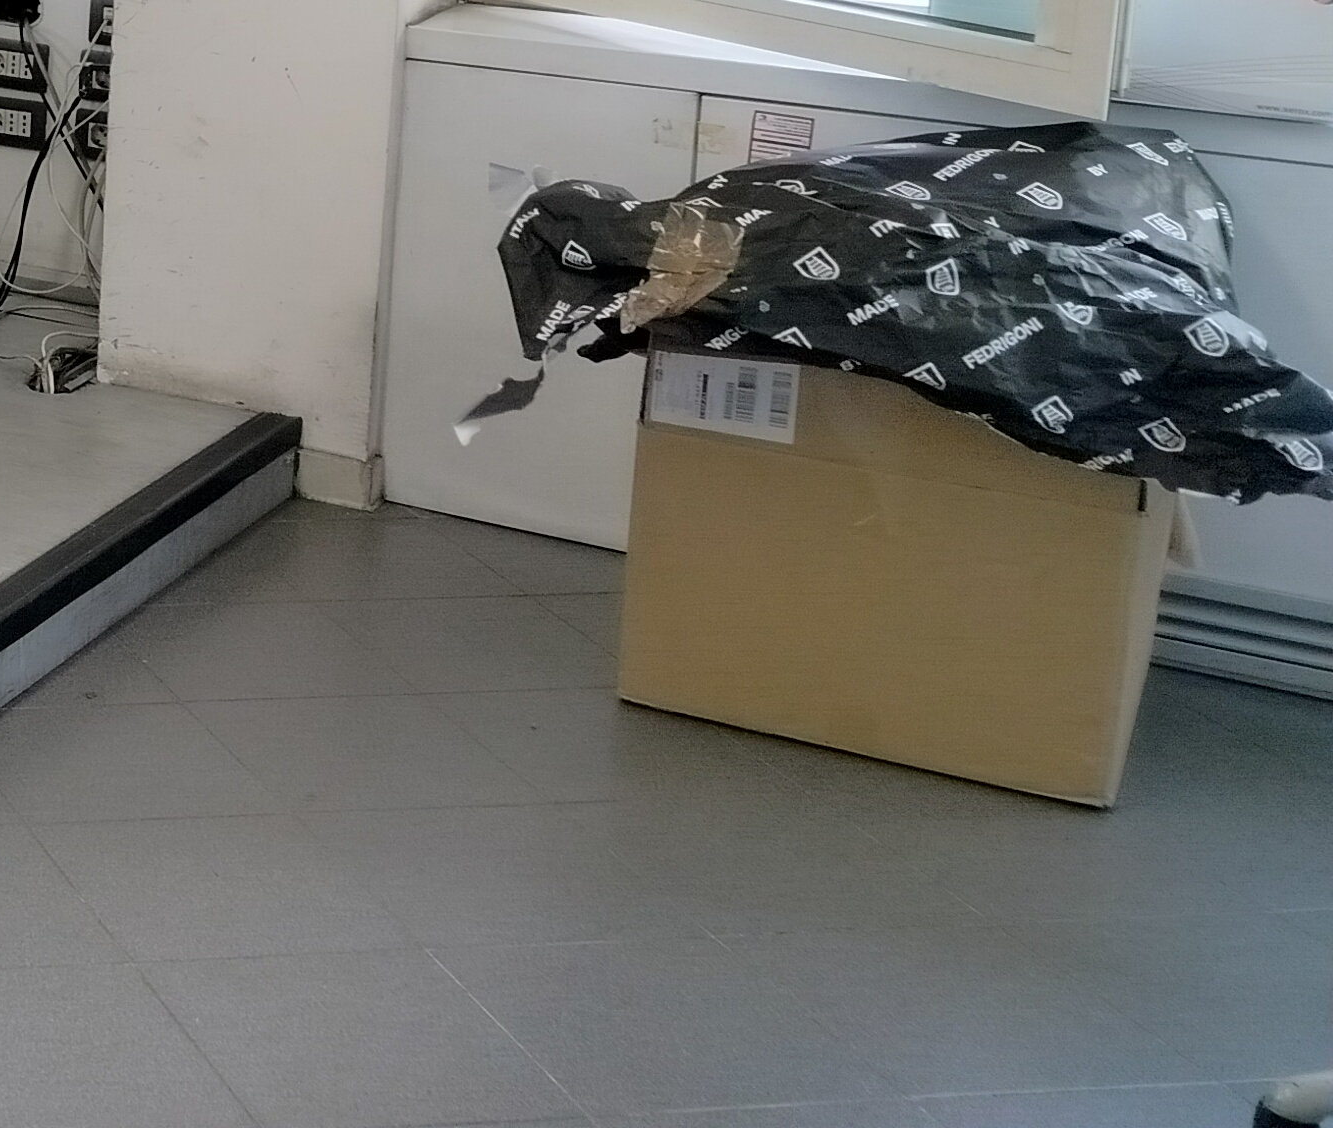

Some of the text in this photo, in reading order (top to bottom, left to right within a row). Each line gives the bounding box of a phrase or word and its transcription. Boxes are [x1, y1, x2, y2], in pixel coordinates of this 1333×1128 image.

[536, 300, 571, 341] MADE
[846, 294, 899, 326] MADE
[962, 316, 1044, 370] FEDRIGONI
[1119, 367, 1143, 386] IN
